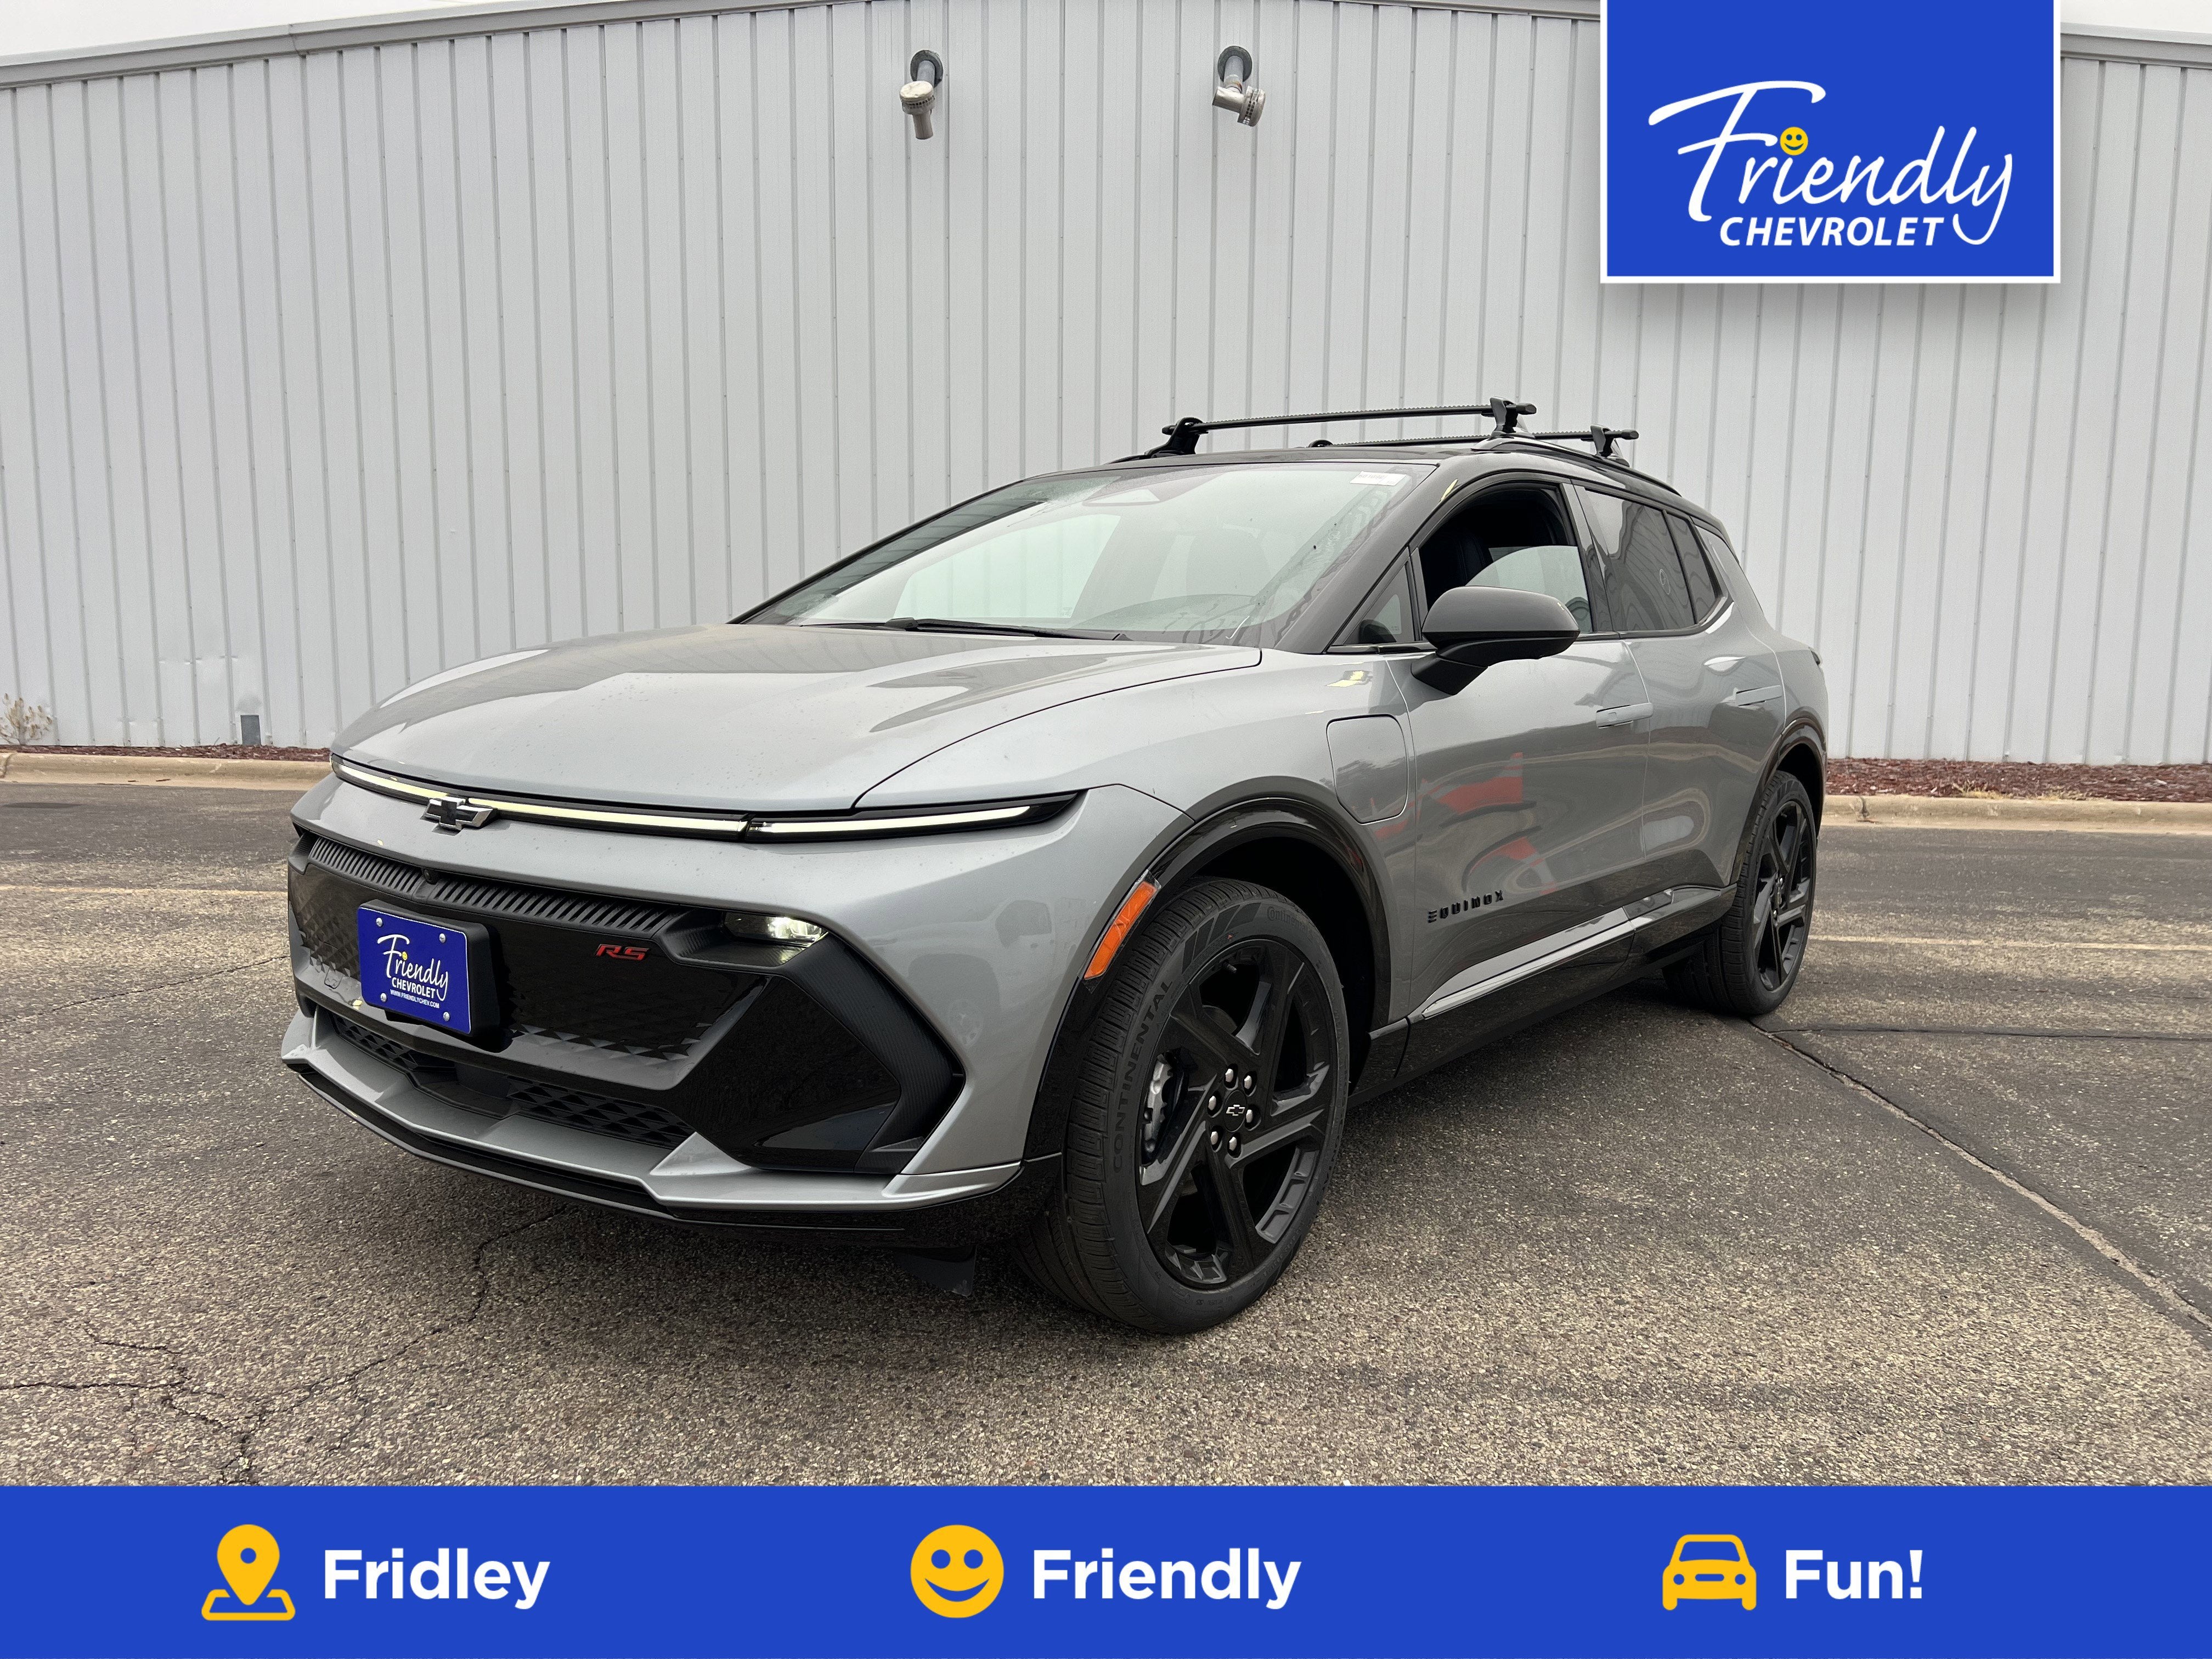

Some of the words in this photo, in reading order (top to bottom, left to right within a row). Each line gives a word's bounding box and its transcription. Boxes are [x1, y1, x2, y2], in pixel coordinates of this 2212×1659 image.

[1427, 889, 1504, 923] EQUINOX
[594, 944, 650, 961] RS
[377, 934, 448, 1001] Friendly
[390, 989, 439, 1009] WWW.FRIENDLYCHEV.COM
[392, 977, 436, 998] CHEVROLET
[1113, 980, 1173, 1173] CONTINENTAL
